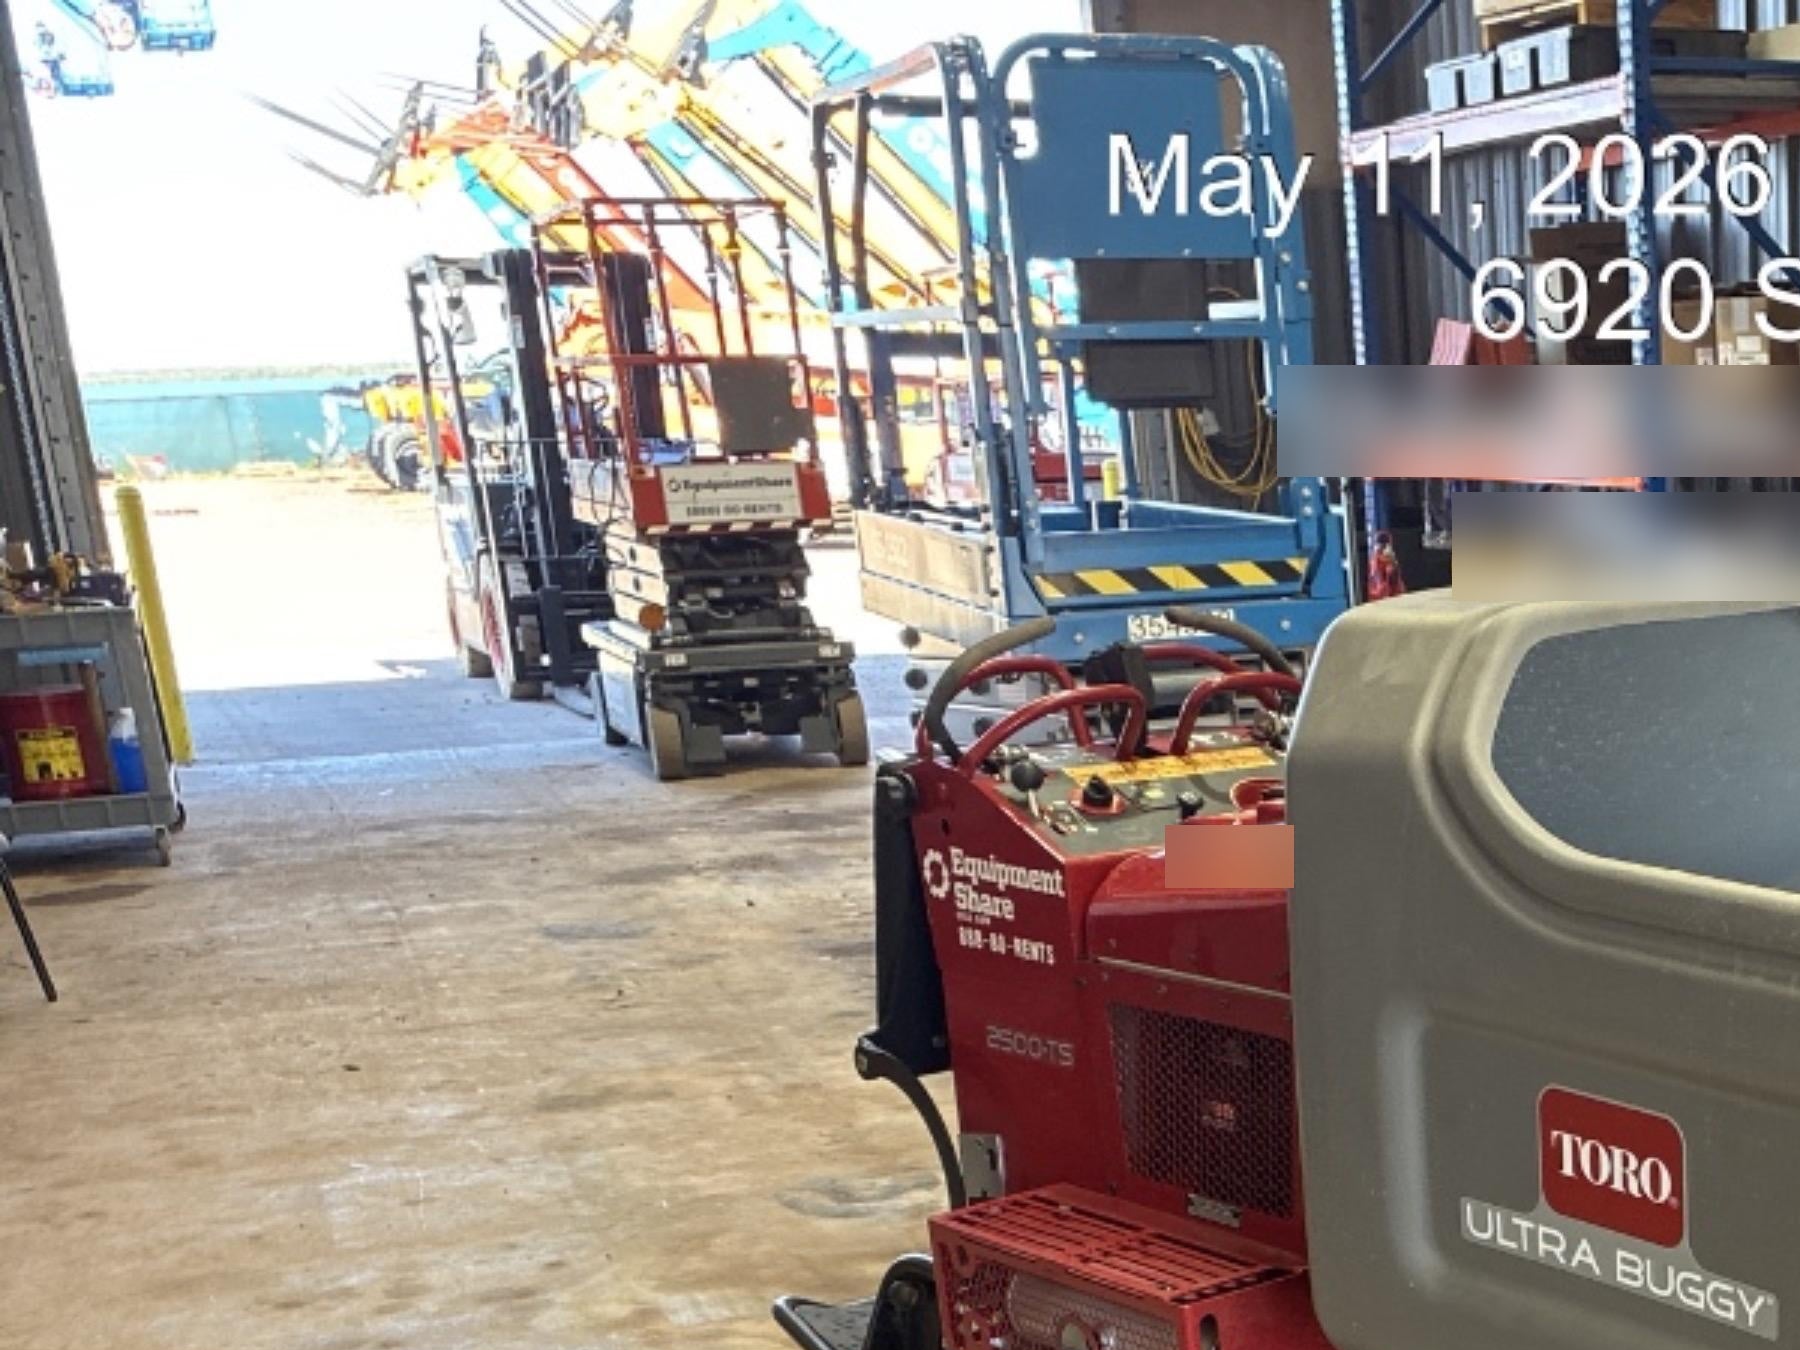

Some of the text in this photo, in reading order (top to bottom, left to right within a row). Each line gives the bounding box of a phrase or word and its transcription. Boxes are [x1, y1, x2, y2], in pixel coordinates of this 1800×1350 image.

[950, 846, 1066, 898] Equipment
[953, 882, 1015, 921] Share
[1550, 1130, 1674, 1205] TORO
[1465, 1202, 1767, 1328] ULTRA BUGGY
